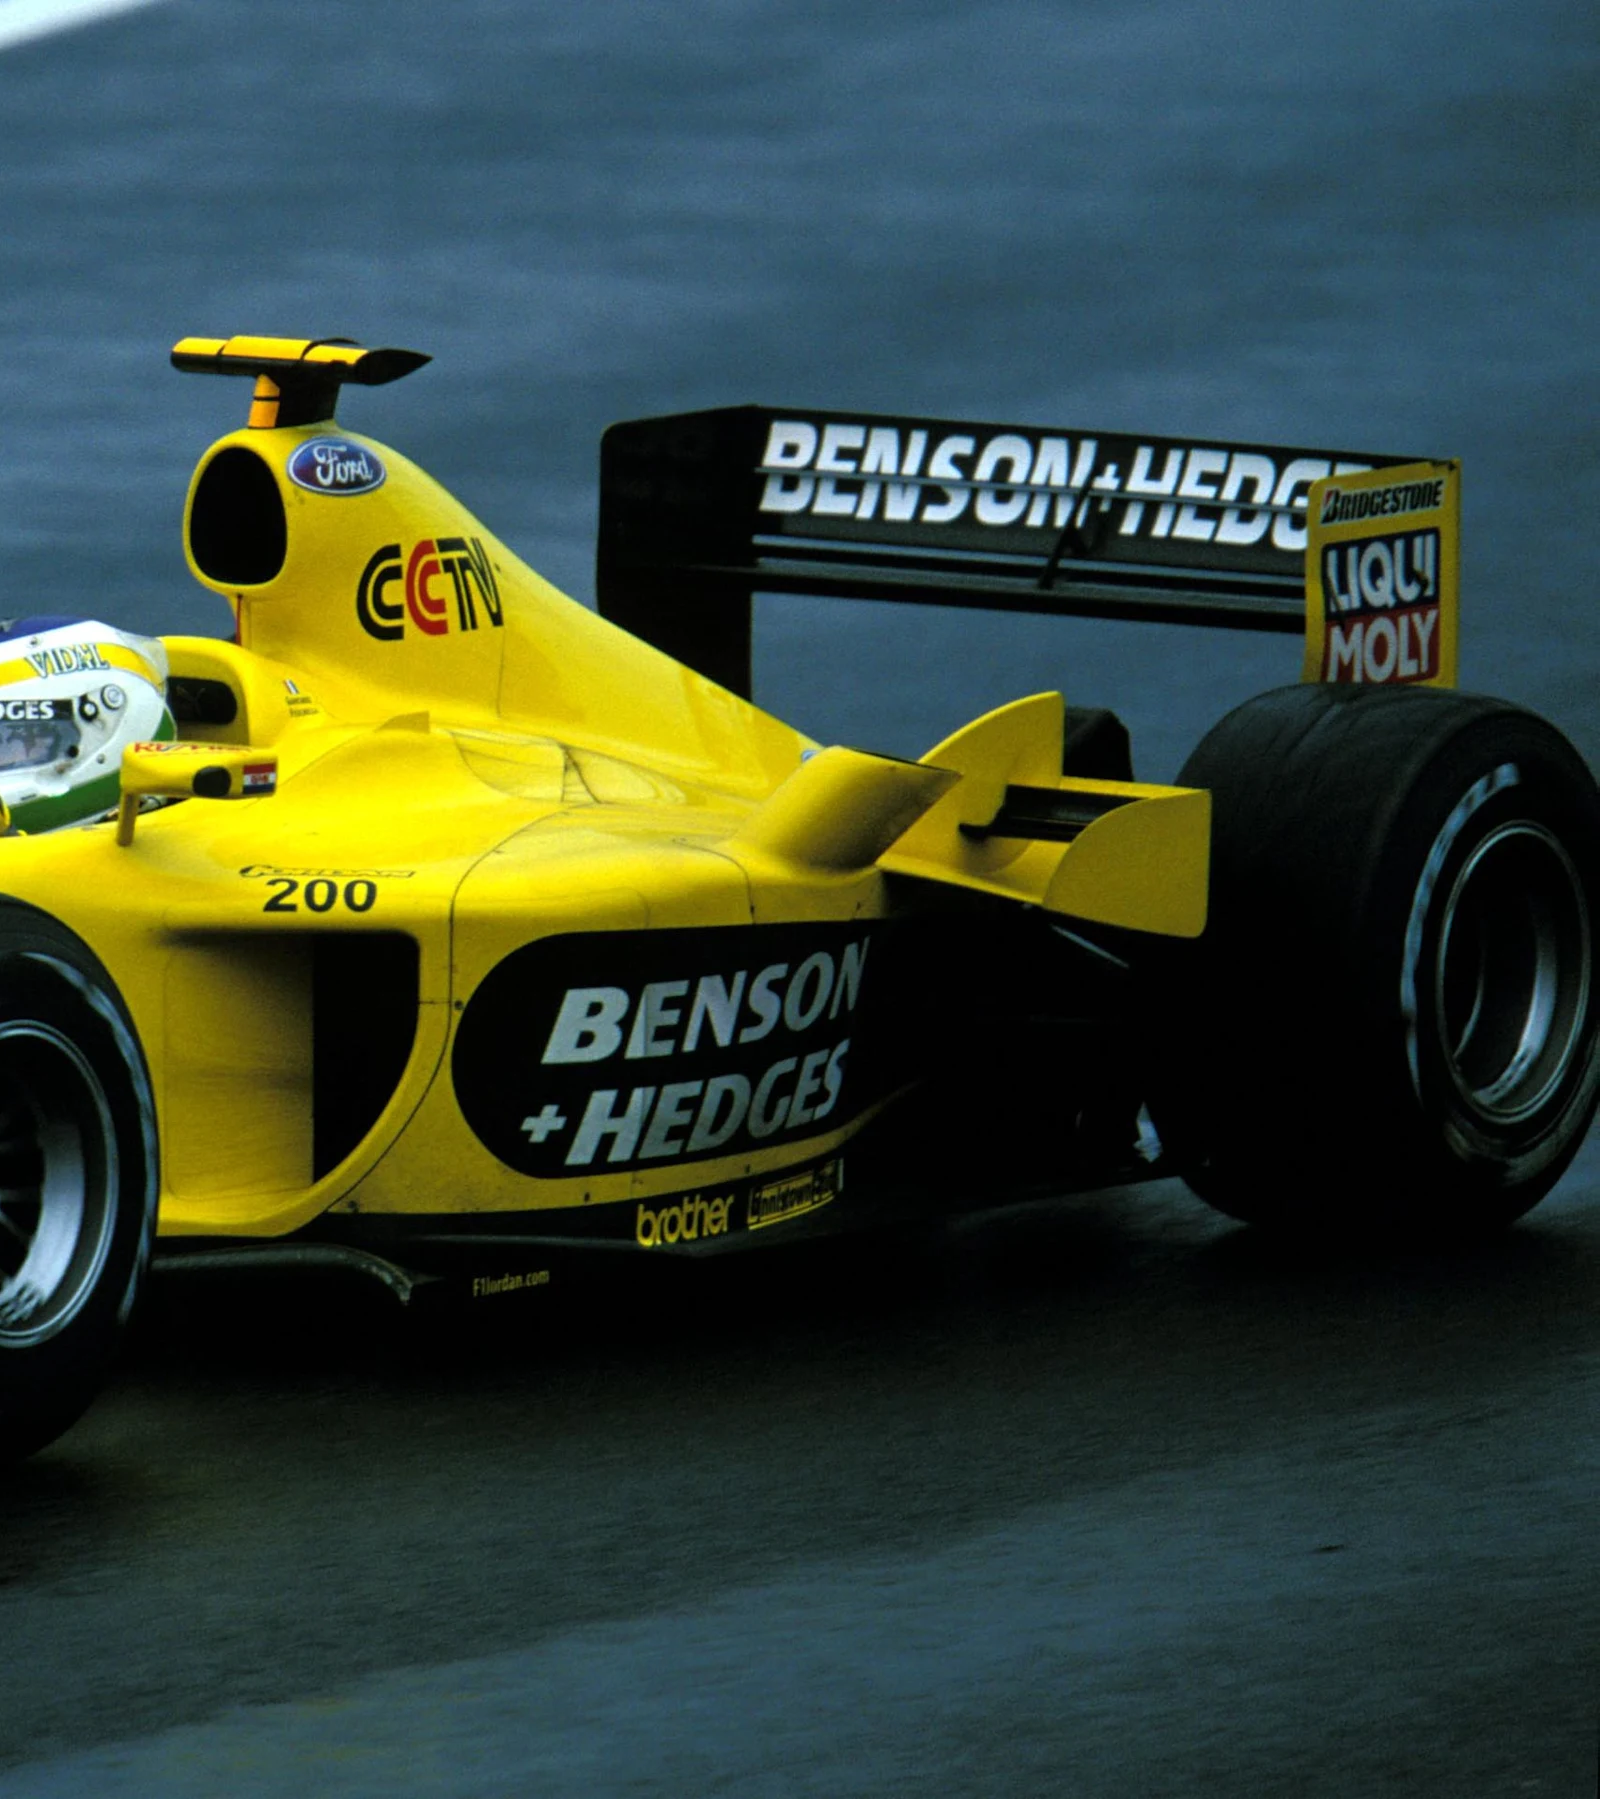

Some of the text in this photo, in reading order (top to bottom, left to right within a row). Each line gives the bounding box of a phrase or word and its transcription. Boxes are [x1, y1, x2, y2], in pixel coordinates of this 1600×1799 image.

[313, 445, 374, 486] Ford
[1322, 480, 1444, 525] BRIDGESTONE
[1327, 533, 1436, 613] LIQUI
[24, 642, 111, 679] VIDAL
[1327, 608, 1439, 684] MOLY
[262, 877, 378, 913] 200
[541, 936, 870, 1065] BENSON
[636, 1194, 734, 1247] brother
